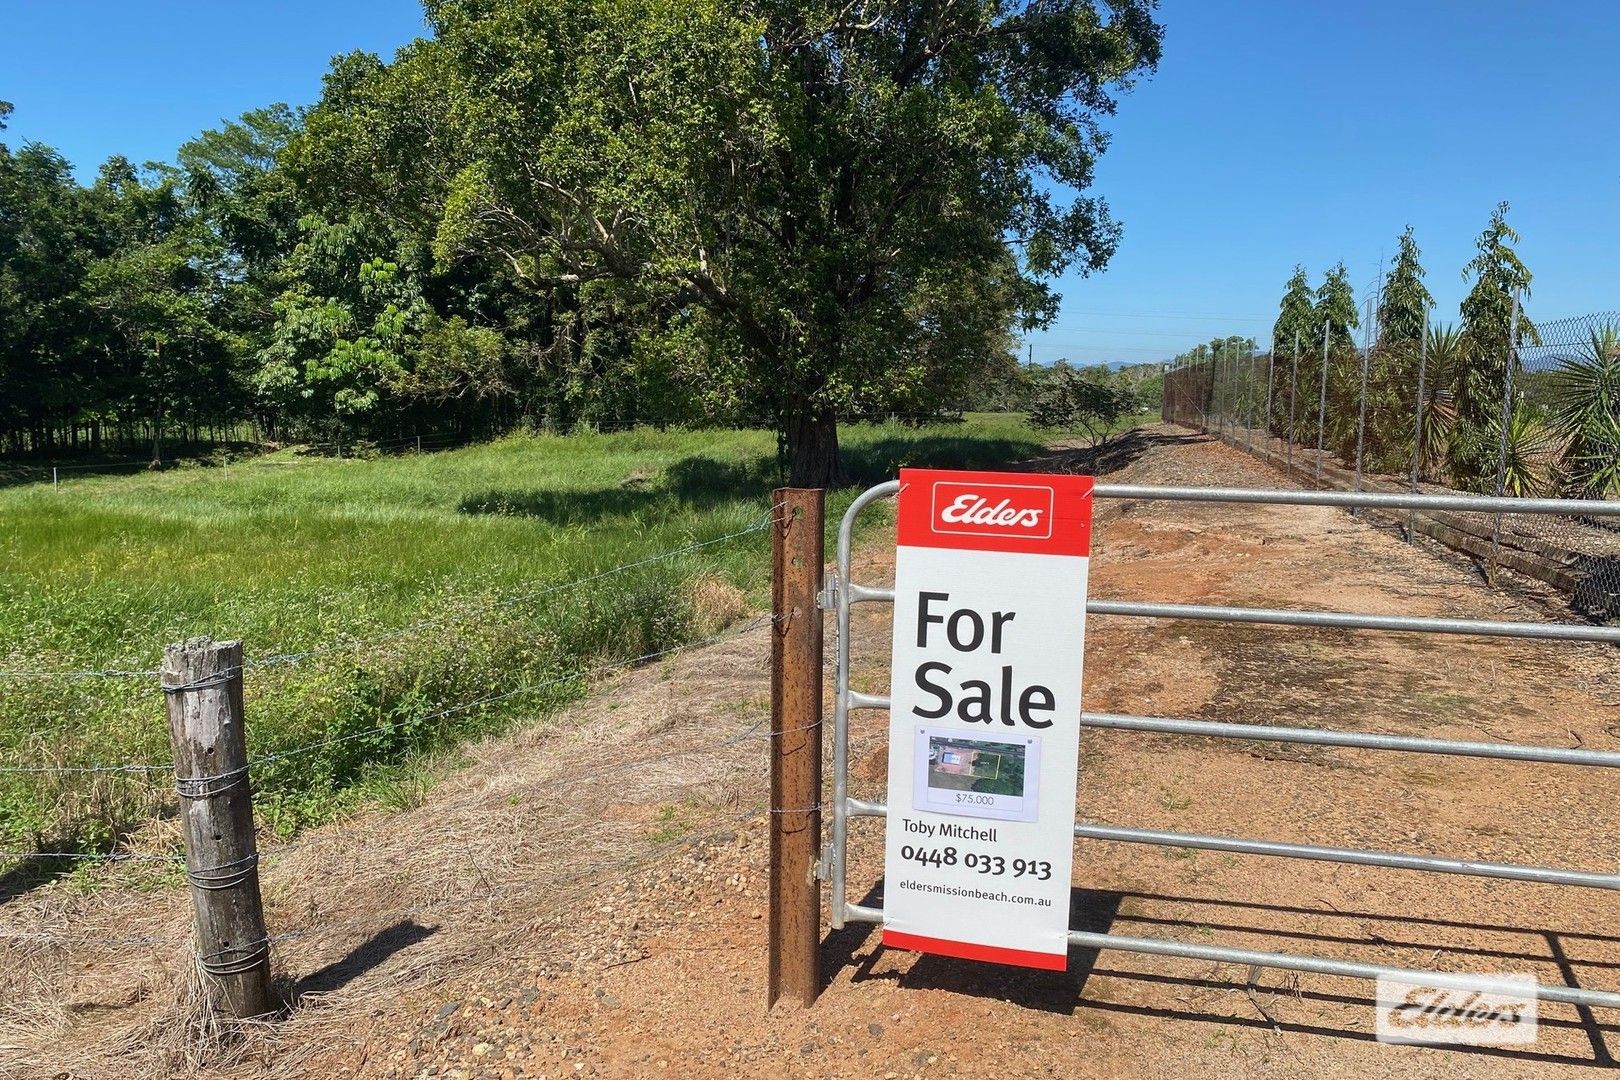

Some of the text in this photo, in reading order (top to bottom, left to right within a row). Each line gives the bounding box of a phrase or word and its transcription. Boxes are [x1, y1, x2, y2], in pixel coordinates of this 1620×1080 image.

[941, 493, 1044, 528] Elders
[916, 591, 1016, 654] For
[911, 661, 1056, 729] Sale
[902, 819, 998, 842] Toby Mitchell
[900, 845, 1052, 880] 0448 033 913
[899, 879, 1051, 907] eldersmissionbeach.com.au
